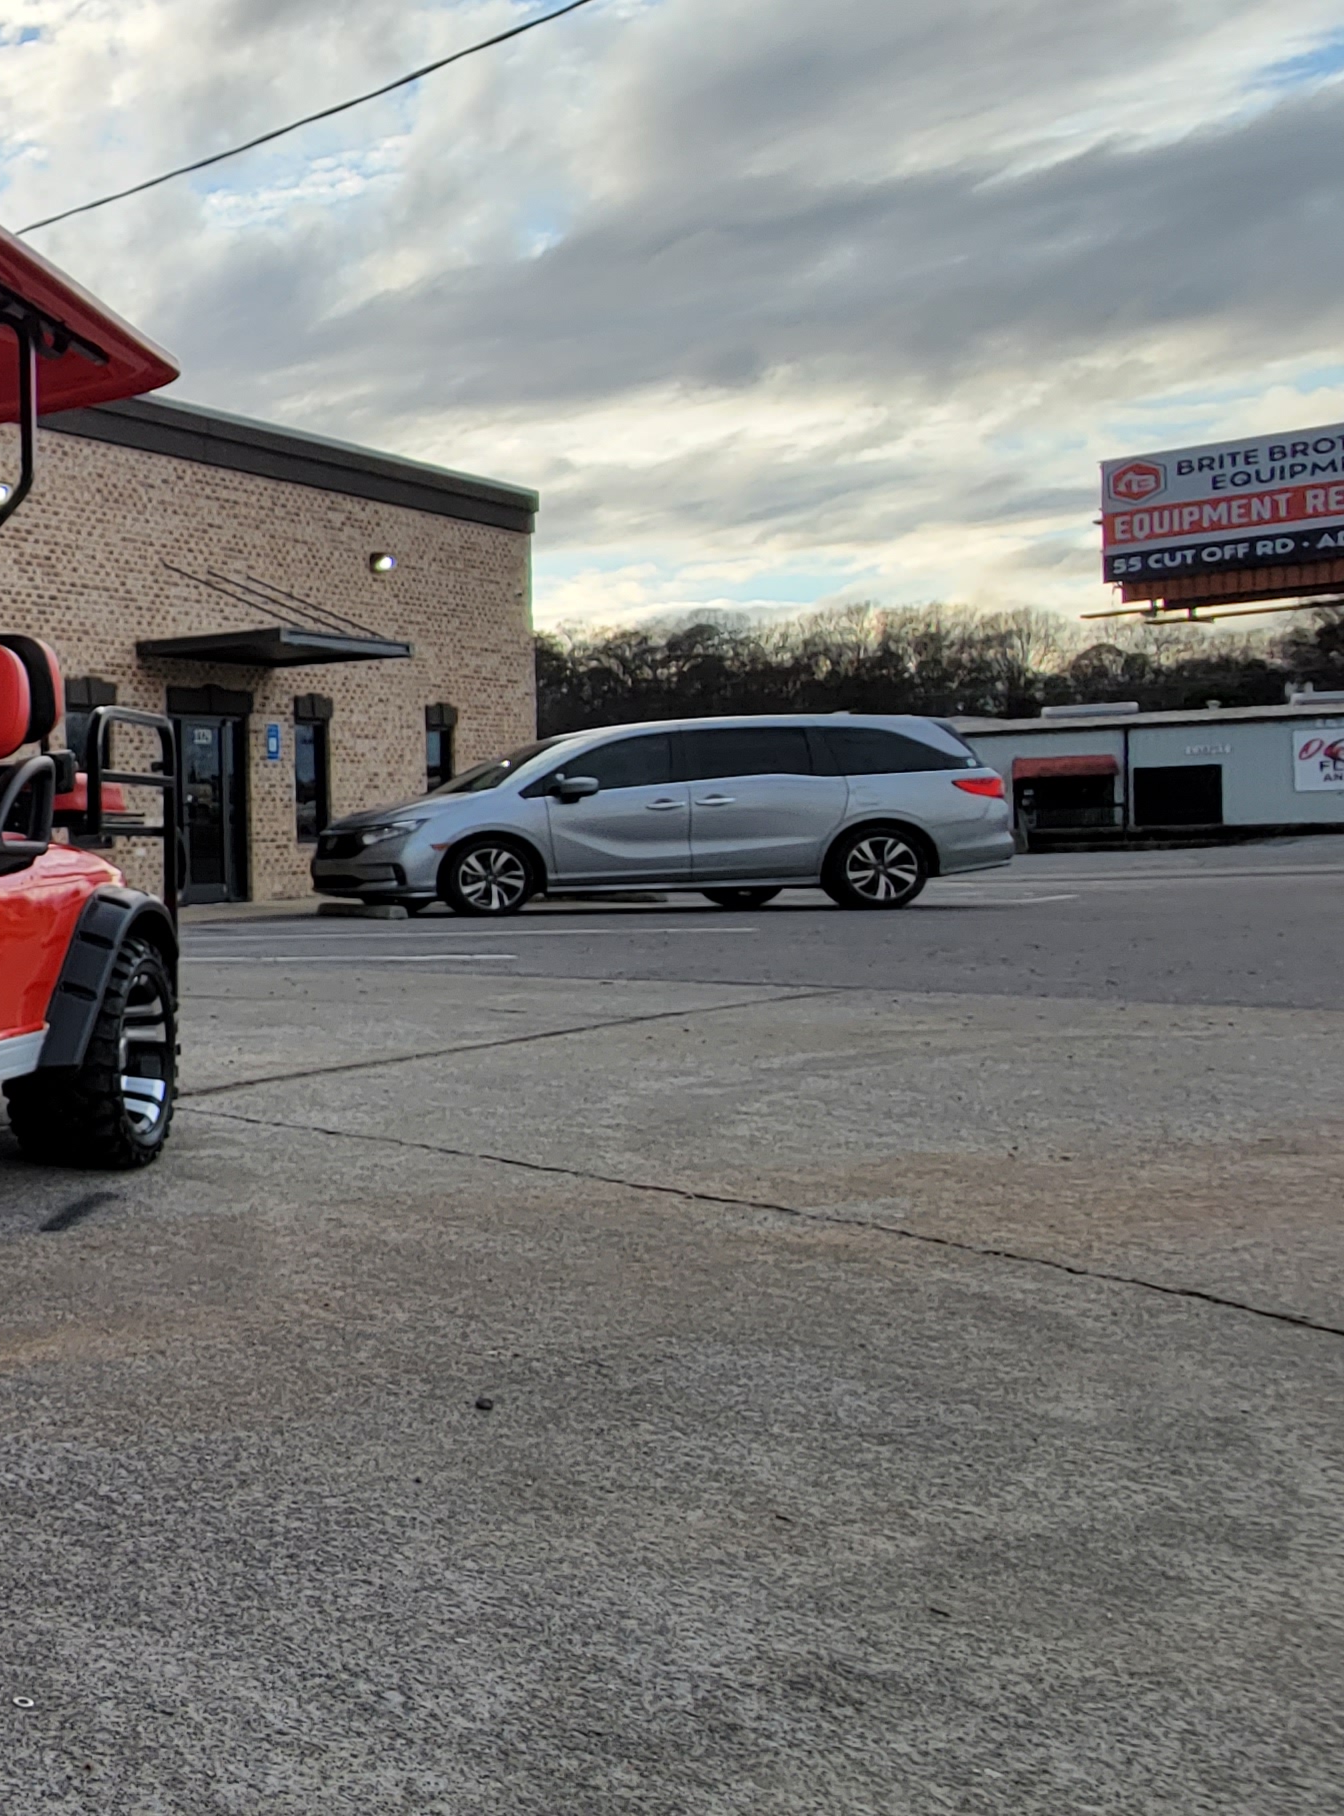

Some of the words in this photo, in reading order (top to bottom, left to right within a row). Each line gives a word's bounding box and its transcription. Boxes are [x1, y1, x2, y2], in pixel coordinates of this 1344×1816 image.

[1177, 449, 1259, 476] BRITE
[1212, 456, 1344, 490] EQUIPM
[1114, 493, 1293, 540] EQUIPMENT
[1305, 485, 1344, 515] RE
[1113, 556, 1142, 574] 55
[1147, 549, 1196, 568] CUT
[1201, 542, 1250, 563] OFF
[1256, 537, 1295, 556] RD
